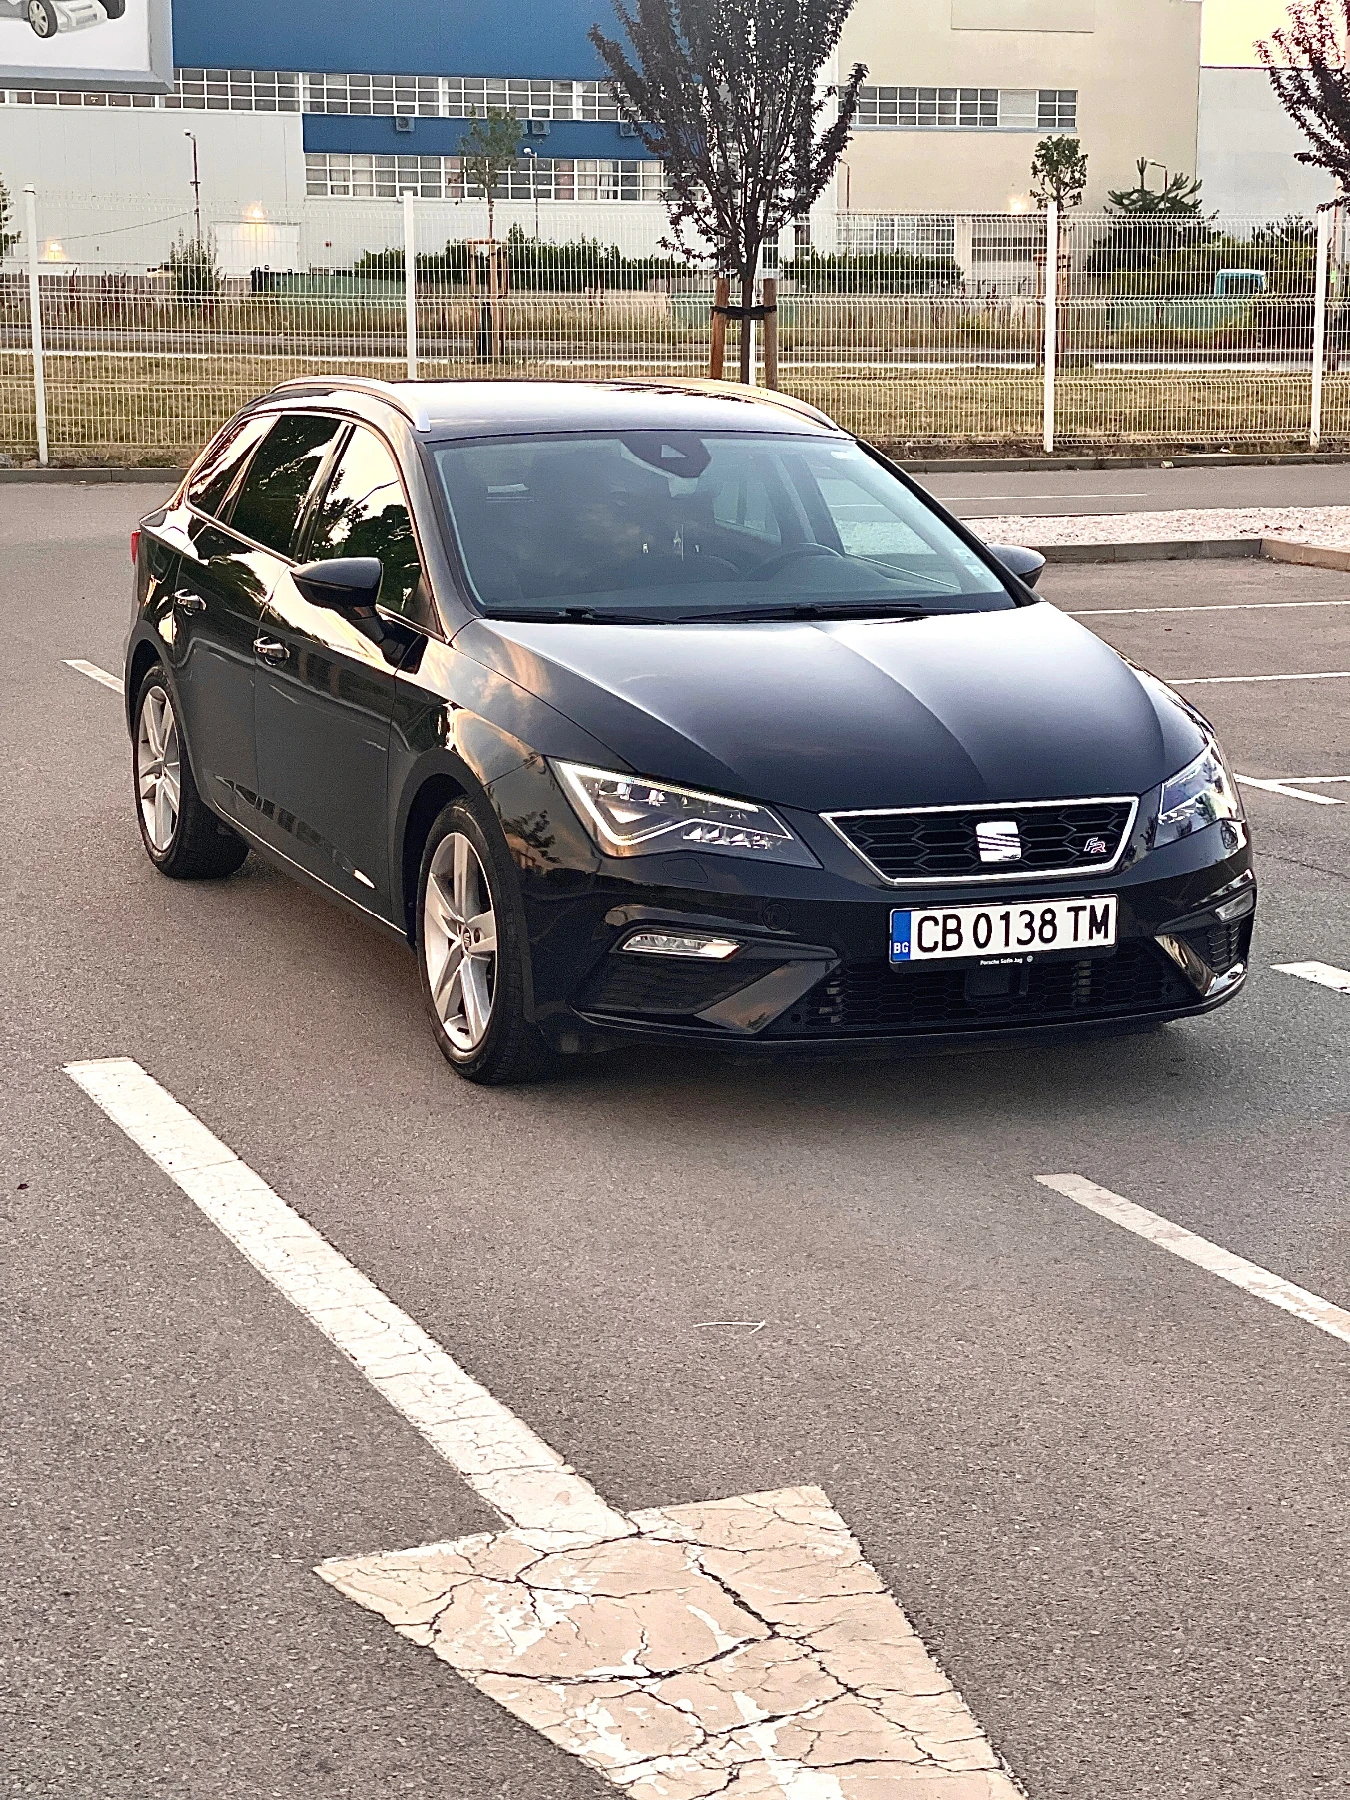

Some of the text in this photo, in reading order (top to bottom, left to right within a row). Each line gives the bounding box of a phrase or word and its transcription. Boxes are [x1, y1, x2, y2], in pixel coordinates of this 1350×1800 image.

[917, 903, 1110, 953] CB 0138 TM
[893, 942, 909, 953] BG
